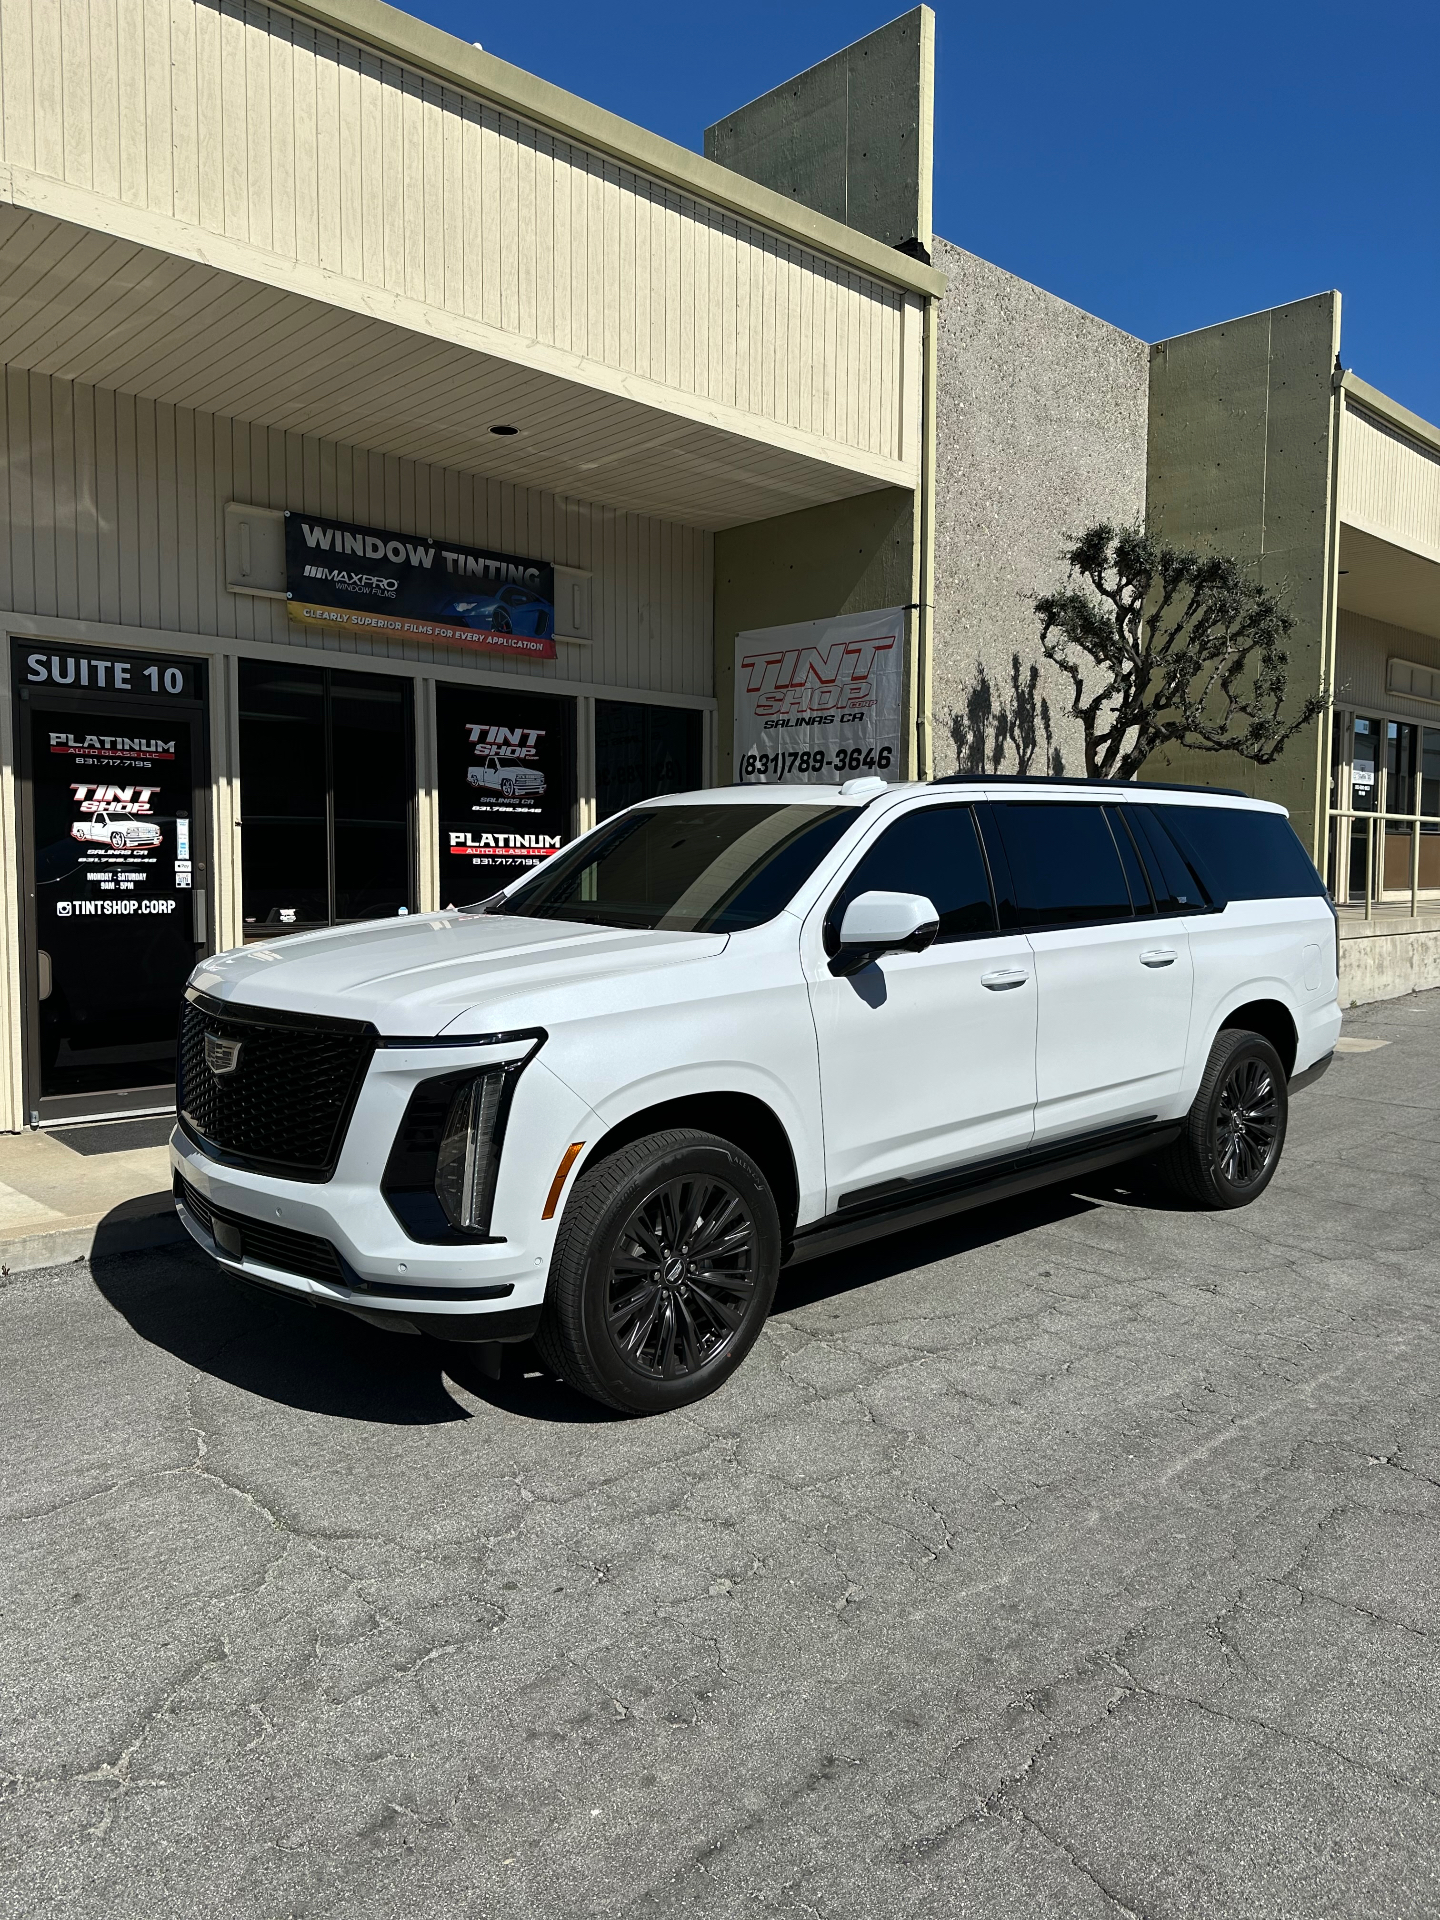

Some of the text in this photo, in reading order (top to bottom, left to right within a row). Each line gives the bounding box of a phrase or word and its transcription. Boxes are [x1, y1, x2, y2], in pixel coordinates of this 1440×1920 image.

[301, 523, 541, 586] WINDOW TINTING
[335, 582, 397, 599] WINDOW FILMS
[303, 608, 544, 651] CLEARLY SUPERIOR FILMS FOR EVERY APPLICATION
[27, 654, 184, 694] SUITE 10
[741, 636, 896, 693] TINT
[754, 682, 877, 716] SHOP CORP
[764, 712, 864, 729] SALINAS CA
[49, 733, 176, 752] PLATINUM
[465, 724, 546, 747] TINT
[474, 744, 536, 759] SHOP
[76, 758, 152, 767] 831.717.7195
[739, 746, 892, 782] (831)789-3646
[70, 783, 161, 803] TINT
[80, 801, 150, 814] SHOP
[449, 832, 561, 848] PLATINUM
[75, 900, 176, 915] TINTSHOP.CORP
